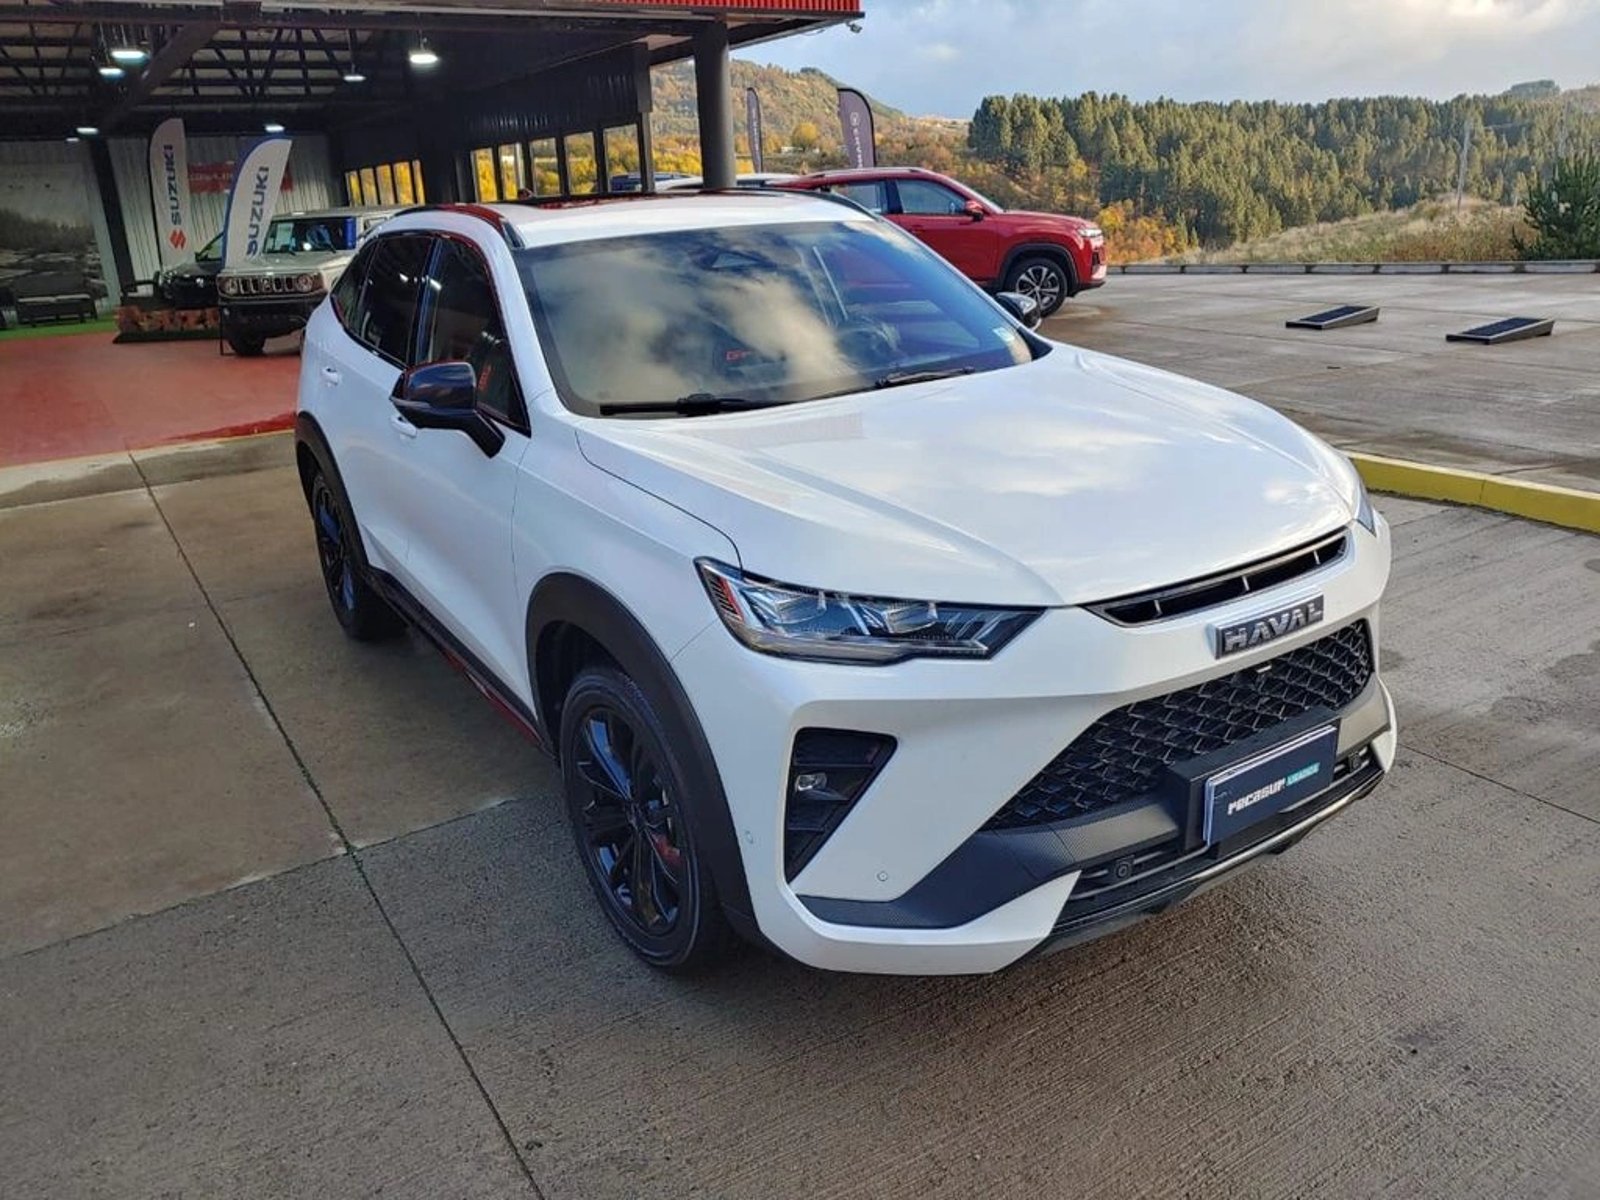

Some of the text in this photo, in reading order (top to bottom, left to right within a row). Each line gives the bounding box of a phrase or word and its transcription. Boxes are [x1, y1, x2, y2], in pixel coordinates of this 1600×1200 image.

[163, 143, 182, 226] SUZUKI
[246, 166, 269, 256] SUZUKI
[1224, 603, 1322, 652] HAVAL
